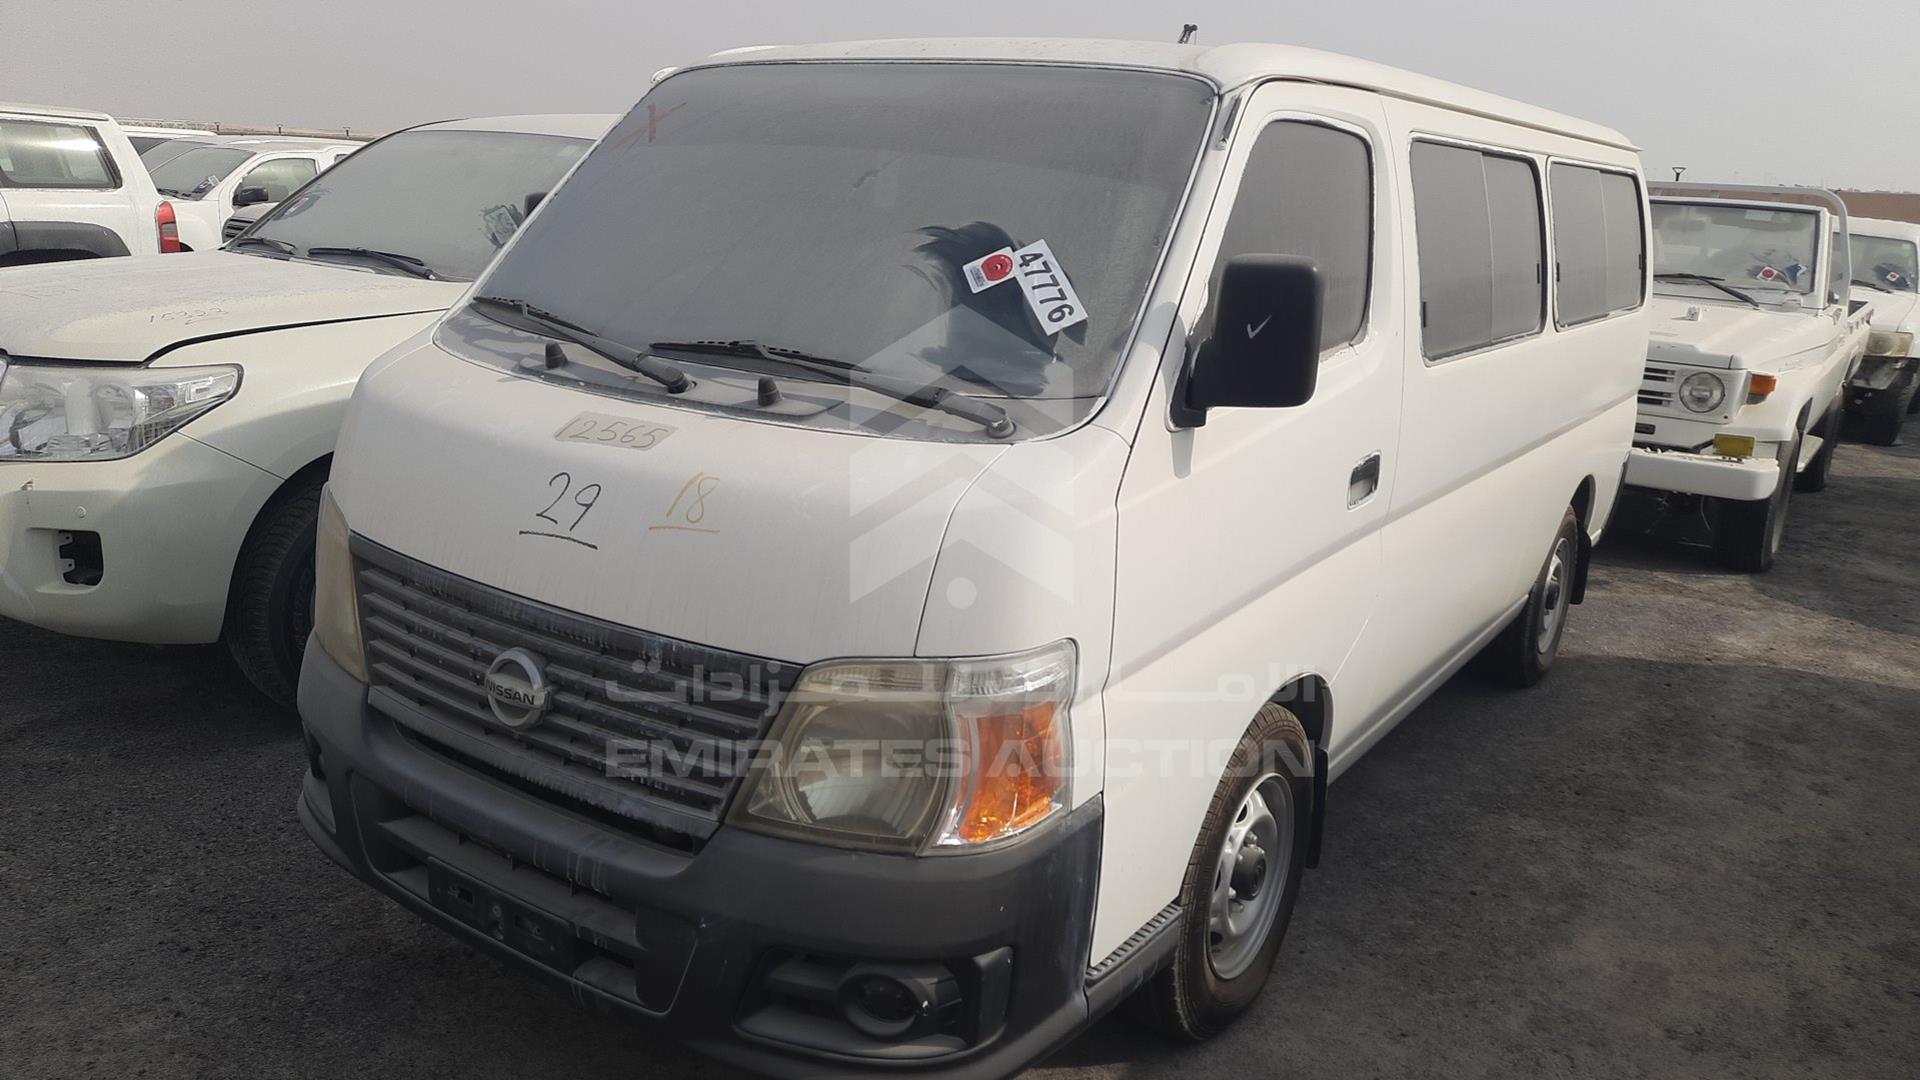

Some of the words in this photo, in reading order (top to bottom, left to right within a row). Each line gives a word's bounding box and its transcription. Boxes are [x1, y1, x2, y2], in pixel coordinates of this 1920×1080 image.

[1018, 252, 1076, 323] 47776
[536, 472, 602, 532] 29
[666, 472, 720, 524] 18
[484, 678, 535, 706] NISSAN
